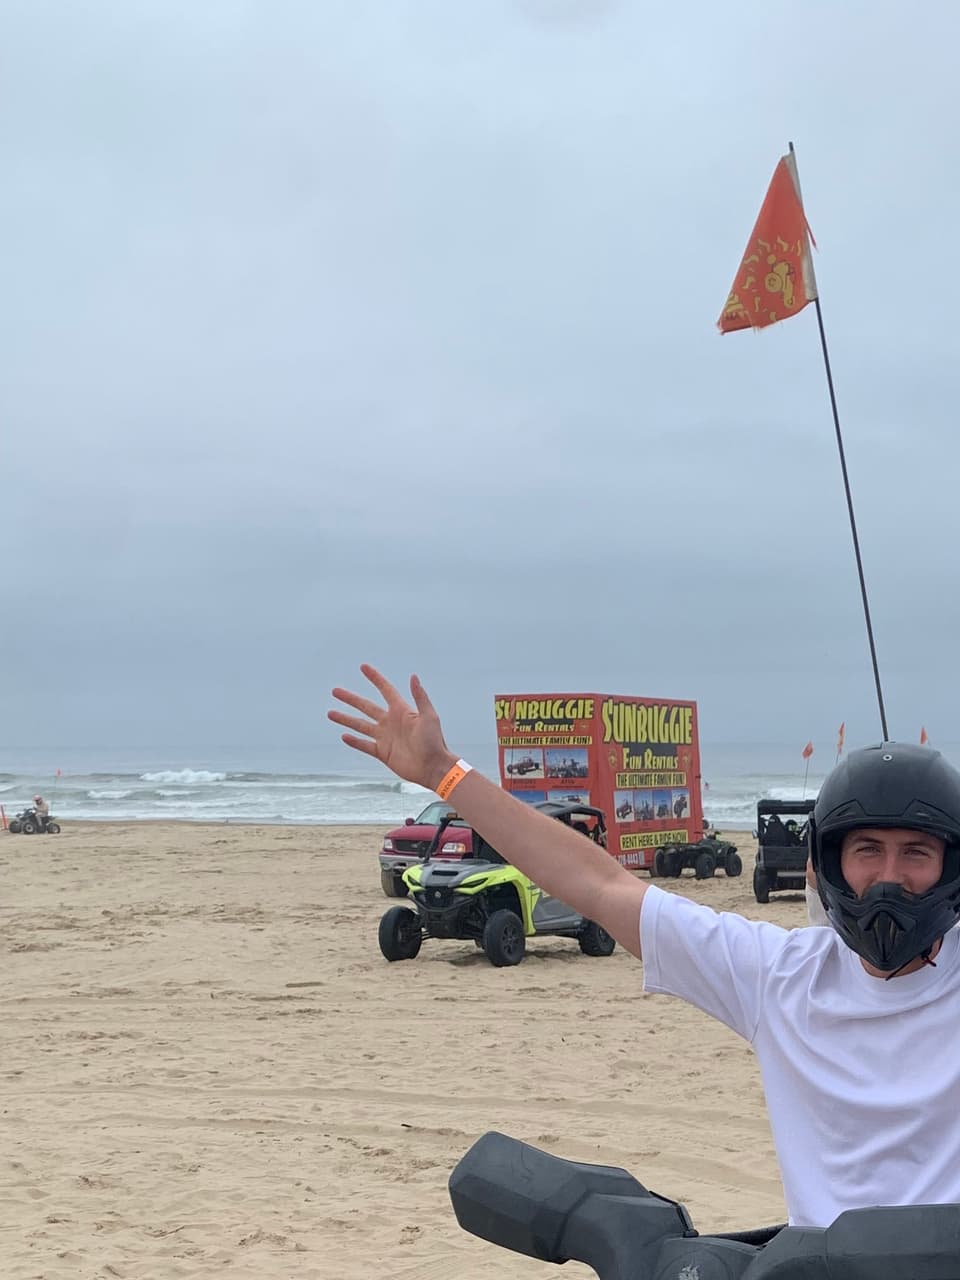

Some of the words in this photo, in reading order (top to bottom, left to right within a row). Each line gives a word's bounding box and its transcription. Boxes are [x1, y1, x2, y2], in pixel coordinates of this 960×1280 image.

[495, 698, 595, 720] SUNBUGGIE
[514, 721, 532, 733] FUN
[534, 720, 575, 733] RENTALS
[602, 698, 693, 745] SUNBUGGIE
[622, 747, 642, 770] FUN
[644, 748, 679, 770] RENTALS
[622, 835, 638, 850] RENT
[639, 833, 654, 848] HERE
